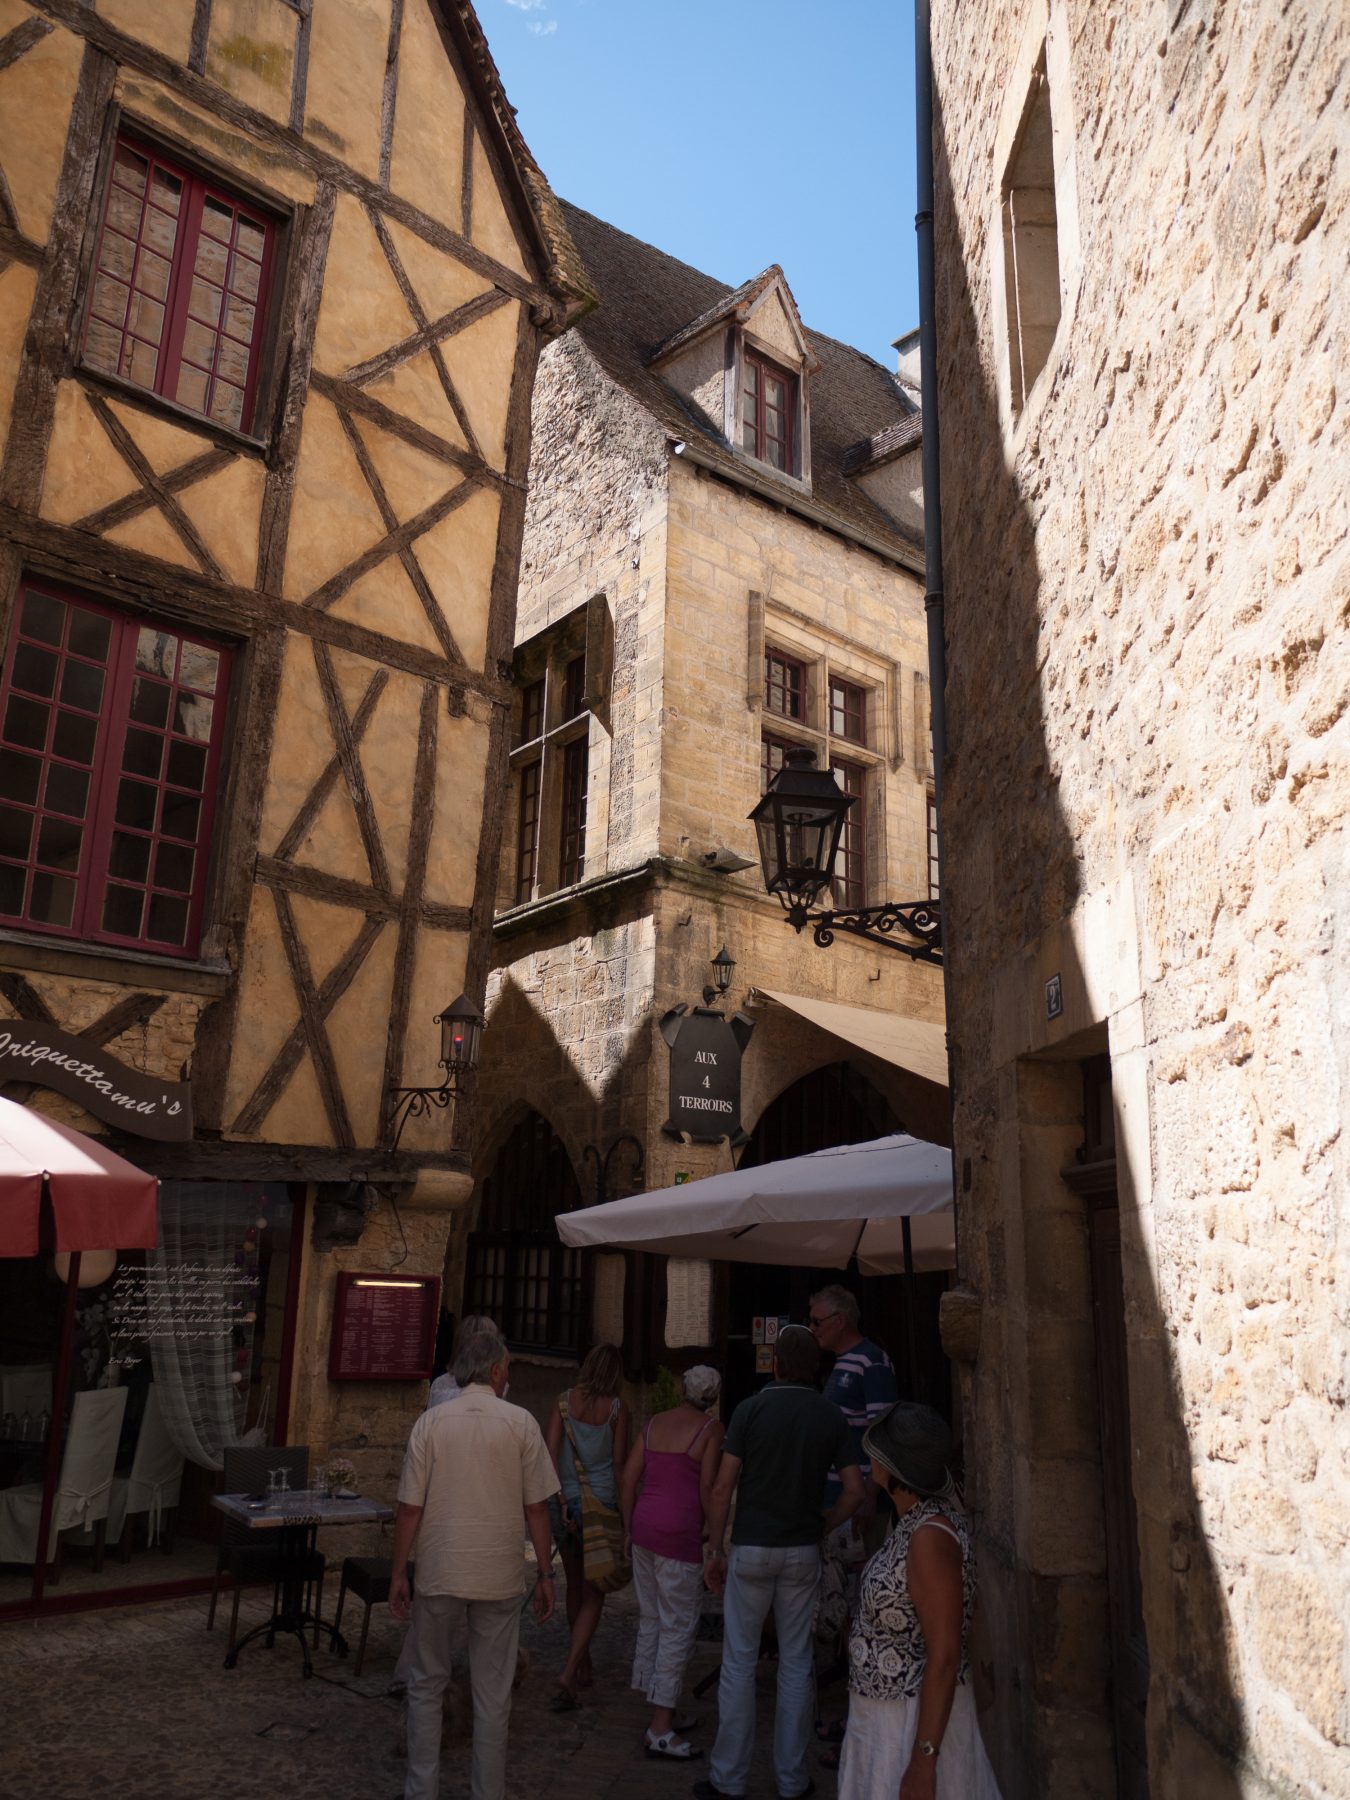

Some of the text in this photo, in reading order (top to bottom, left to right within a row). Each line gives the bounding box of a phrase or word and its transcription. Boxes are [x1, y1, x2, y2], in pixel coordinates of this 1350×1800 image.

[1049, 985, 1057, 1010] 2
[694, 1050, 717, 1065] AUX
[702, 1075, 710, 1088] 4
[679, 1095, 733, 1113] TERROIRS
